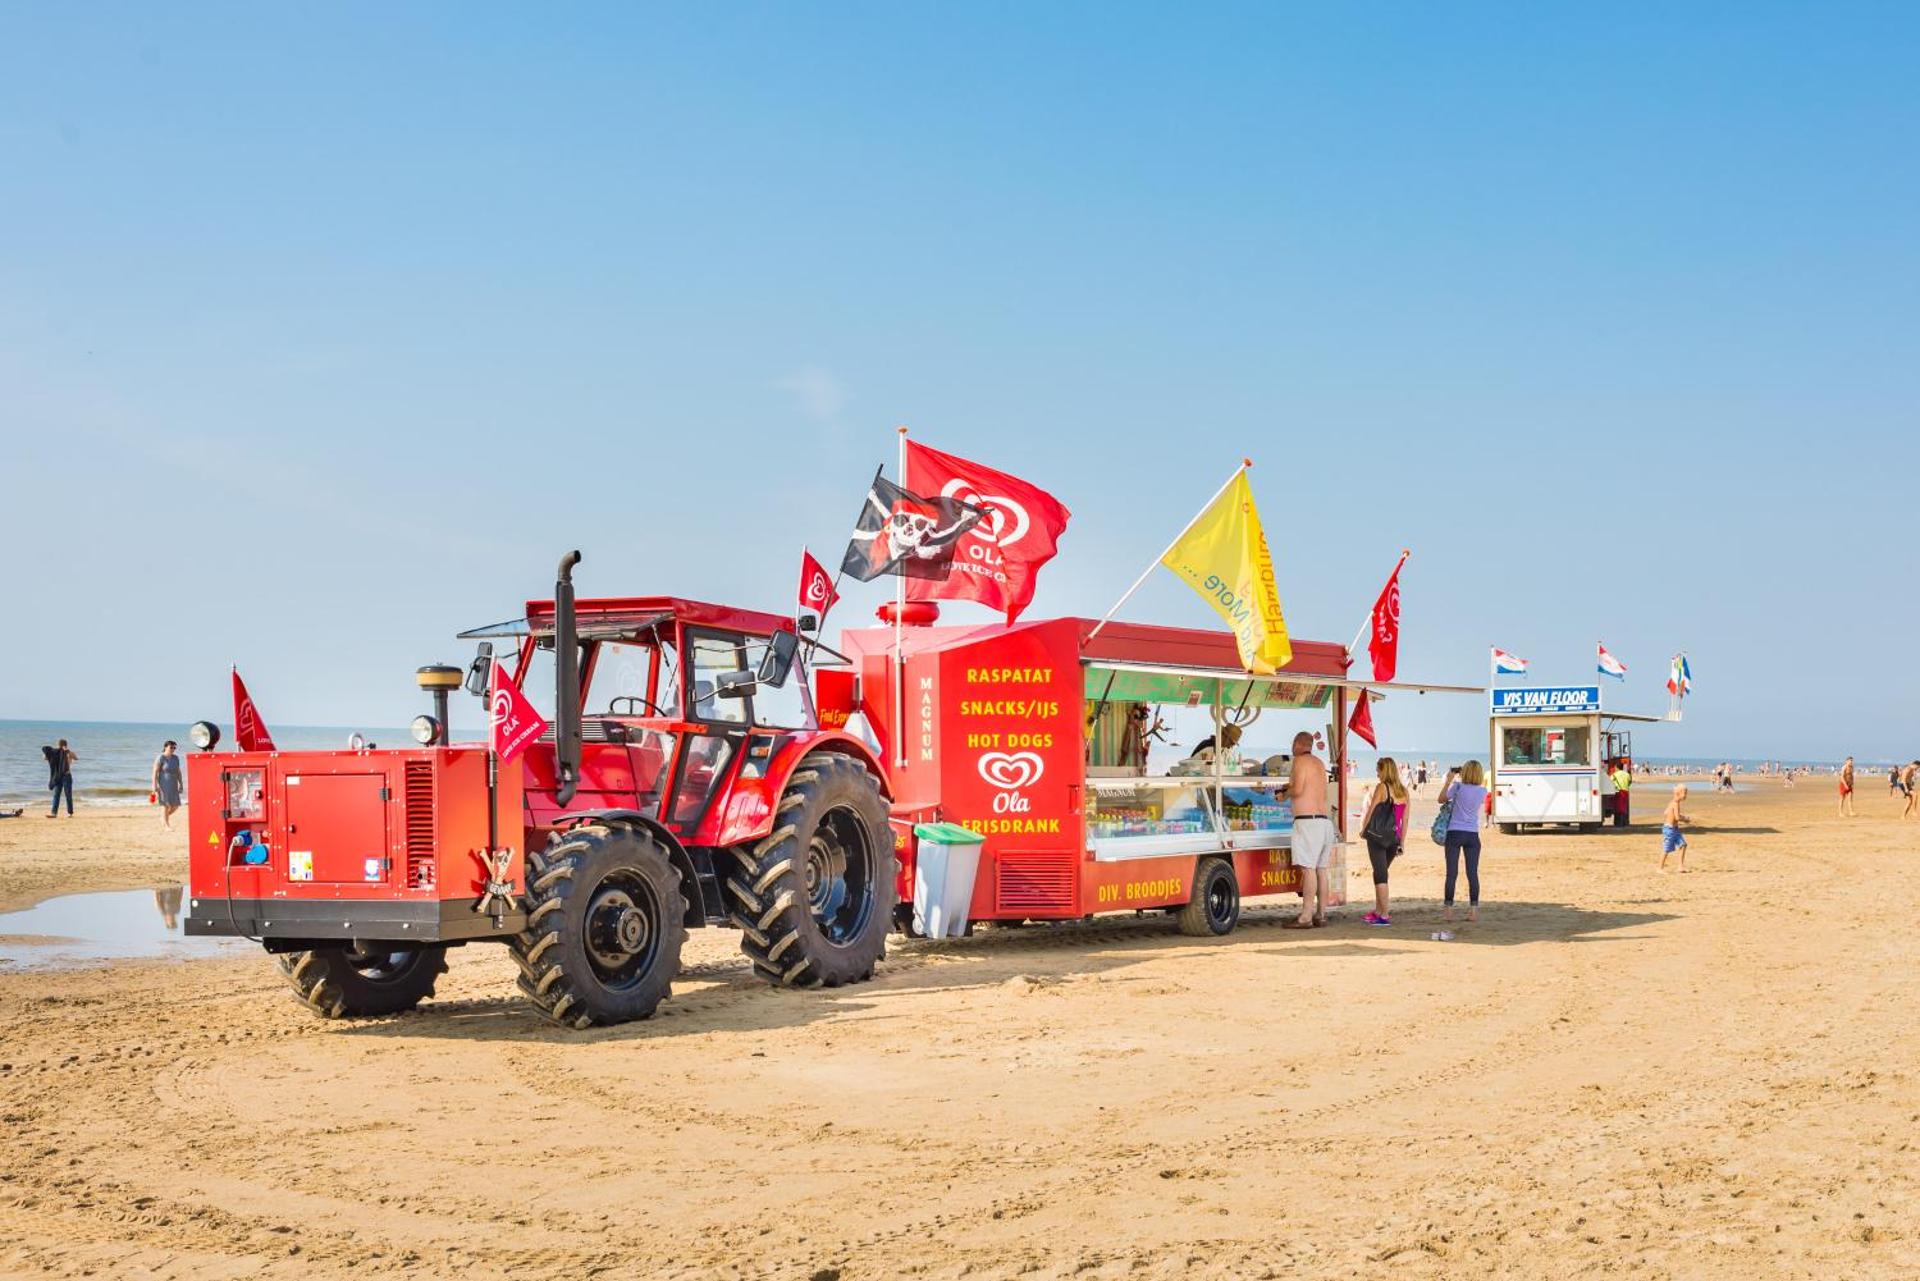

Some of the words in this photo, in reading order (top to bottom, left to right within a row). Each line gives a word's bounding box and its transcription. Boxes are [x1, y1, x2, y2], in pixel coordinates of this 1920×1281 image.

[967, 668, 1053, 683] RASPATAT
[1504, 692, 1523, 706] VIS
[1524, 691, 1548, 706] VAN
[1549, 690, 1589, 705] FLOOR
[960, 700, 1060, 719] SNACKS/IJS
[920, 678, 933, 761] MAGNUM
[968, 734, 1000, 748] HOT
[1008, 734, 1053, 748] DOGS
[992, 790, 1030, 813] Ola
[1099, 884, 1122, 902] DIV.
[1126, 878, 1181, 900] BROODJES
